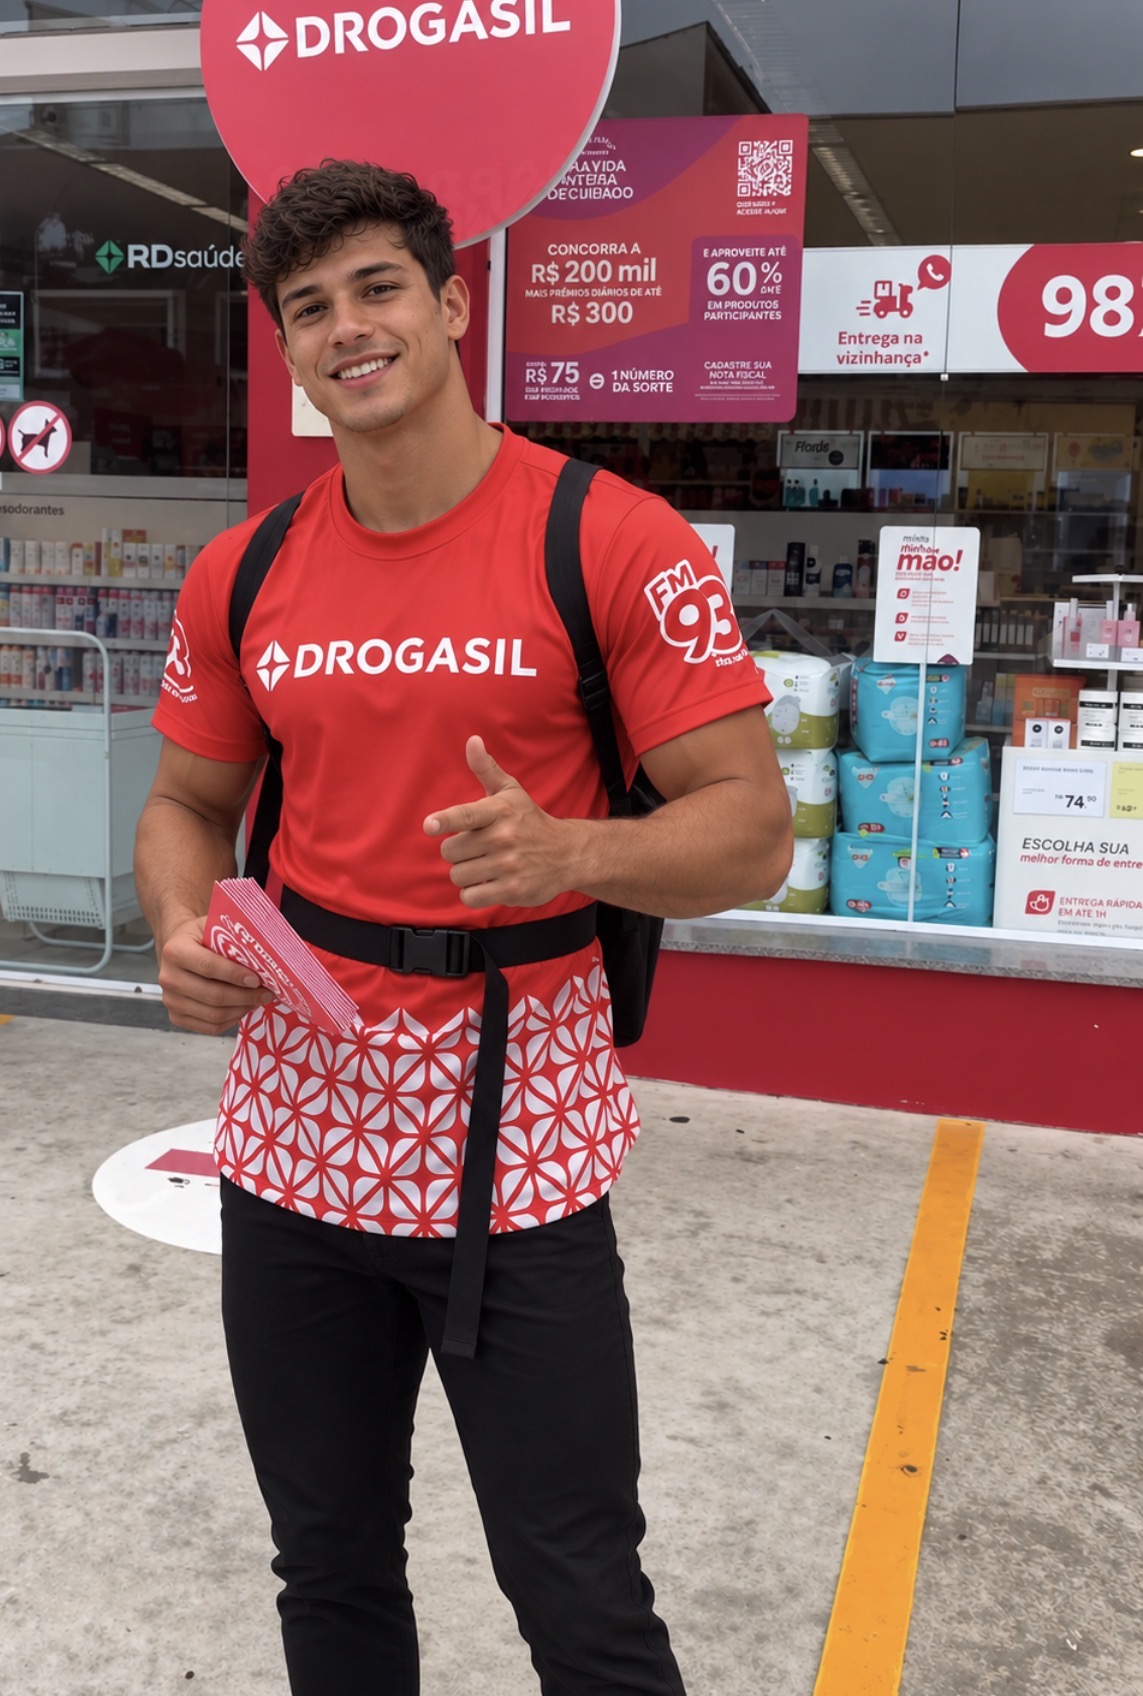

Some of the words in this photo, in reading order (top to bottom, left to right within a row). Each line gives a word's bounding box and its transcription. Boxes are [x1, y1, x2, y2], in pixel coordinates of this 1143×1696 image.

[296, 0, 571, 58] DROGASIL
[548, 243, 627, 255] CONCORRA
[630, 243, 641, 254] A
[703, 248, 709, 258] E
[711, 248, 765, 258] APROVEITE
[768, 245, 787, 257] ATÉ
[128, 244, 245, 269] RDsaúde
[531, 262, 560, 286] R$
[565, 260, 612, 283] 200
[618, 257, 657, 283] mil
[525, 288, 547, 298] MAIS
[631, 288, 643, 297] DE
[645, 285, 662, 297] ATÉ
[707, 301, 722, 311] EM
[724, 300, 779, 311] PRODUTOS
[1041, 275, 1143, 338] 98
[551, 303, 578, 326] R$
[586, 301, 633, 324] 300
[704, 311, 782, 321] PARTICIPANTES
[838, 331, 899, 348] Entrega
[904, 334, 922, 346] na
[704, 361, 751, 370] CADASTRE
[754, 361, 772, 369] SUA
[525, 368, 547, 385] R$
[551, 362, 579, 384] 75
[620, 367, 674, 381] NÚMERO
[710, 371, 734, 379] NOTA
[613, 382, 630, 393] DA
[633, 382, 673, 393] SORTE
[648, 562, 695, 617] FM
[662, 575, 742, 663] 93
[293, 637, 537, 678] DROGASIL
[1022, 837, 1095, 853] ESCOLHA
[1099, 842, 1129, 855] SUA
[1020, 853, 1059, 864] melhor
[1061, 854, 1094, 866] forma
[1097, 857, 1111, 867] de
[1060, 897, 1104, 907] ENTREGA
[1058, 908, 1073, 917] EM
[1096, 910, 1107, 919] 1H
